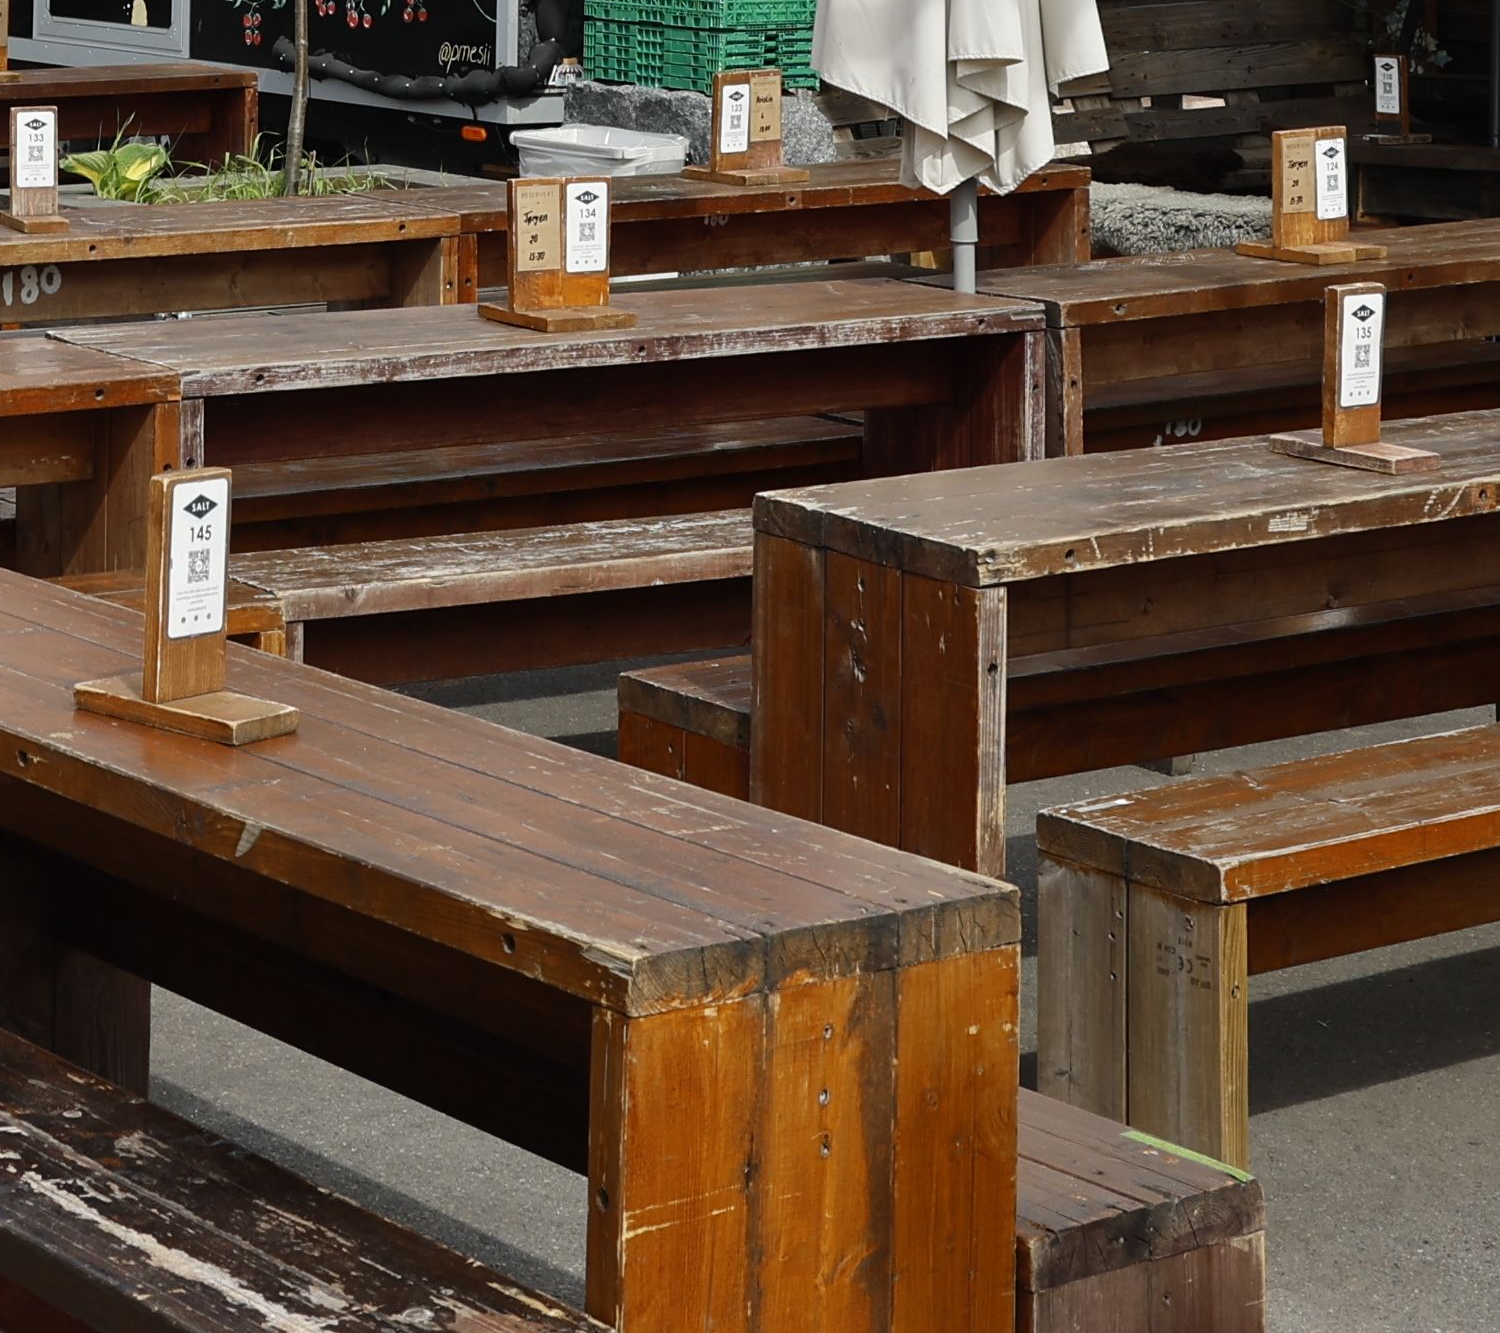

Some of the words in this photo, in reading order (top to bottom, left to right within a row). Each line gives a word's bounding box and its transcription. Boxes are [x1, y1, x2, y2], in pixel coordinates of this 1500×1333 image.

[28, 133, 45, 142] 133
[1326, 161, 1339, 172] 124
[579, 208, 597, 219] 134
[2, 264, 62, 307] 180
[1355, 326, 1373, 340] 135
[191, 501, 211, 513] SALT
[189, 524, 213, 544] 145
